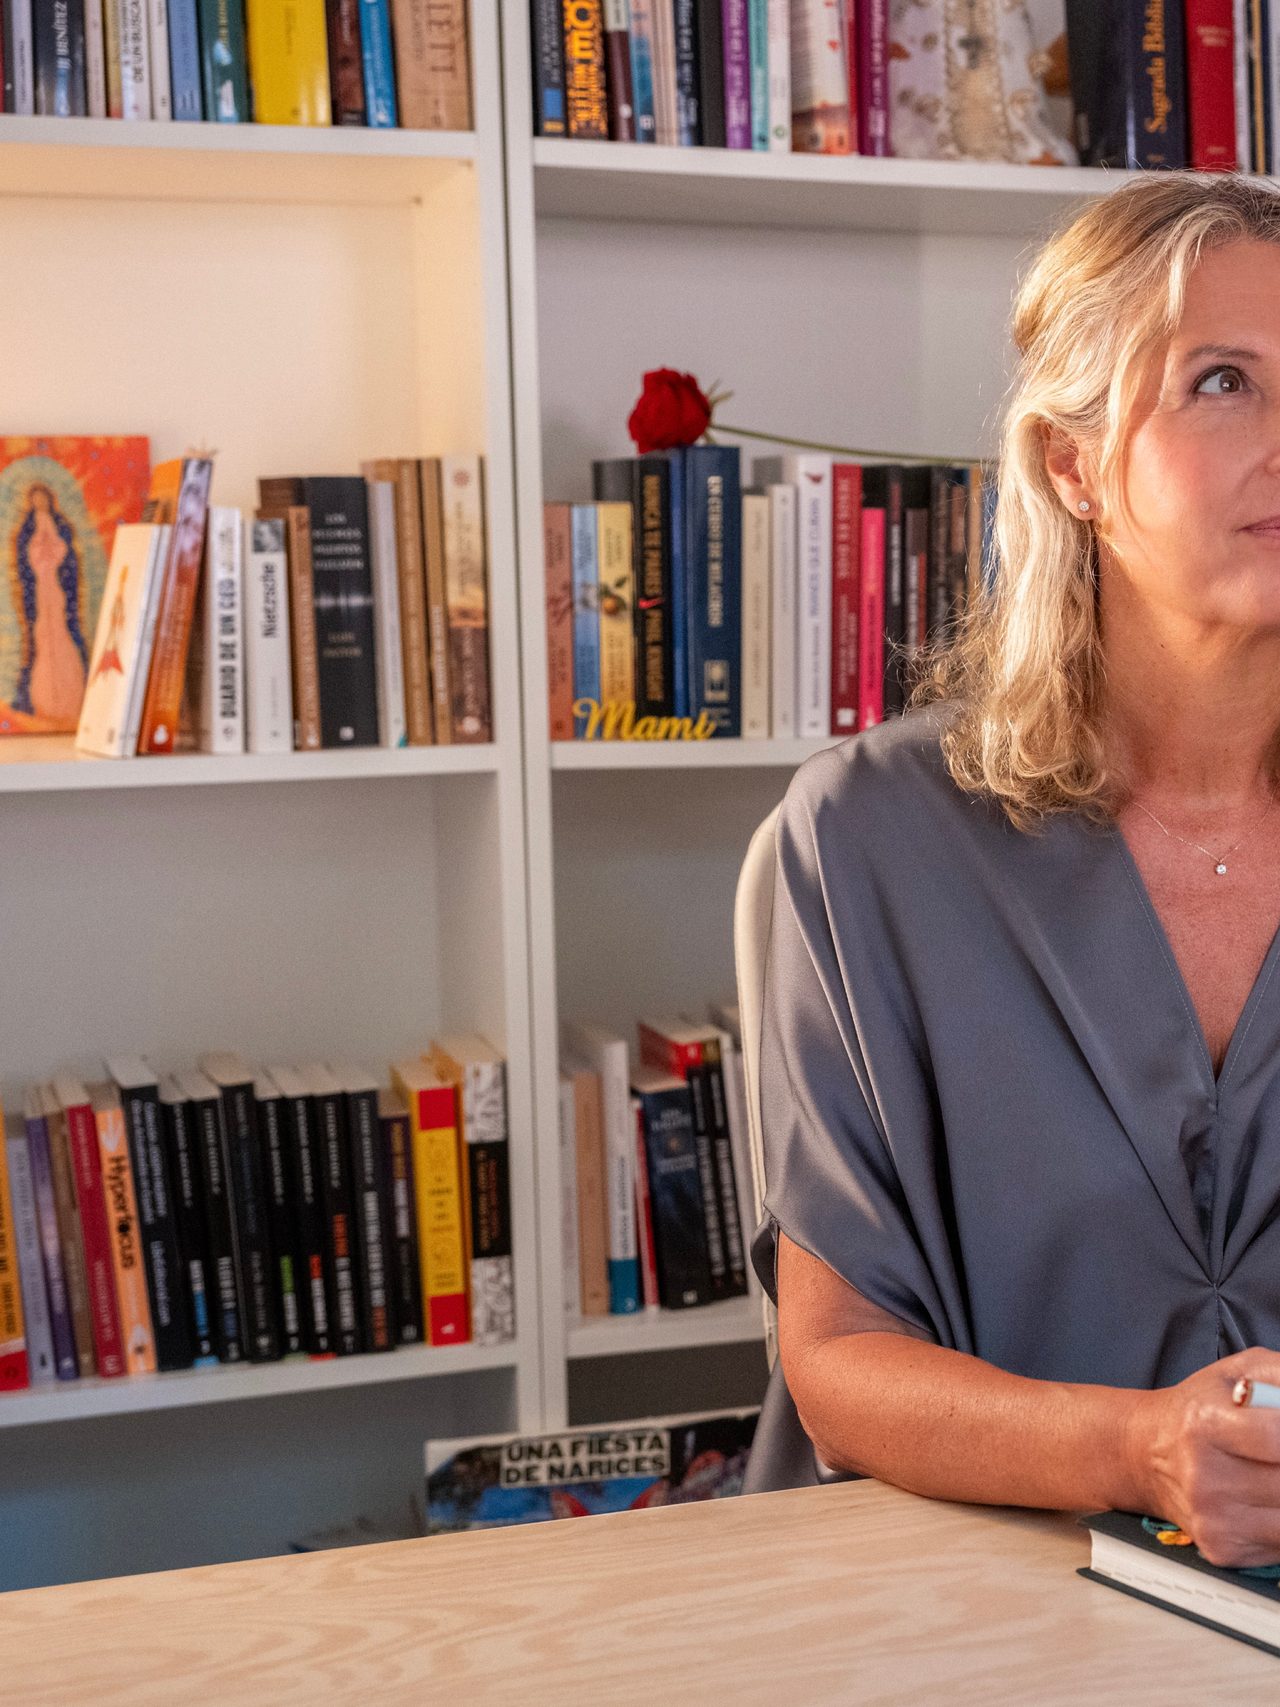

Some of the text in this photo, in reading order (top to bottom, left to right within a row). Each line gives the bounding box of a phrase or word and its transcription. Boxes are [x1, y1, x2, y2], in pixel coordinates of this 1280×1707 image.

[1143, 57, 1171, 134] Sagrada
[643, 475, 661, 528] NUNCA
[645, 530, 661, 546] TE
[645, 549, 662, 597] PARES
[260, 562, 277, 638] Nietzsche
[218, 578, 237, 718] DIARIO DE UN CEO
[573, 697, 718, 741] Mami
[505, 1456, 666, 1484] DE NARICES
[507, 1434, 664, 1462] UNA FIESTA
